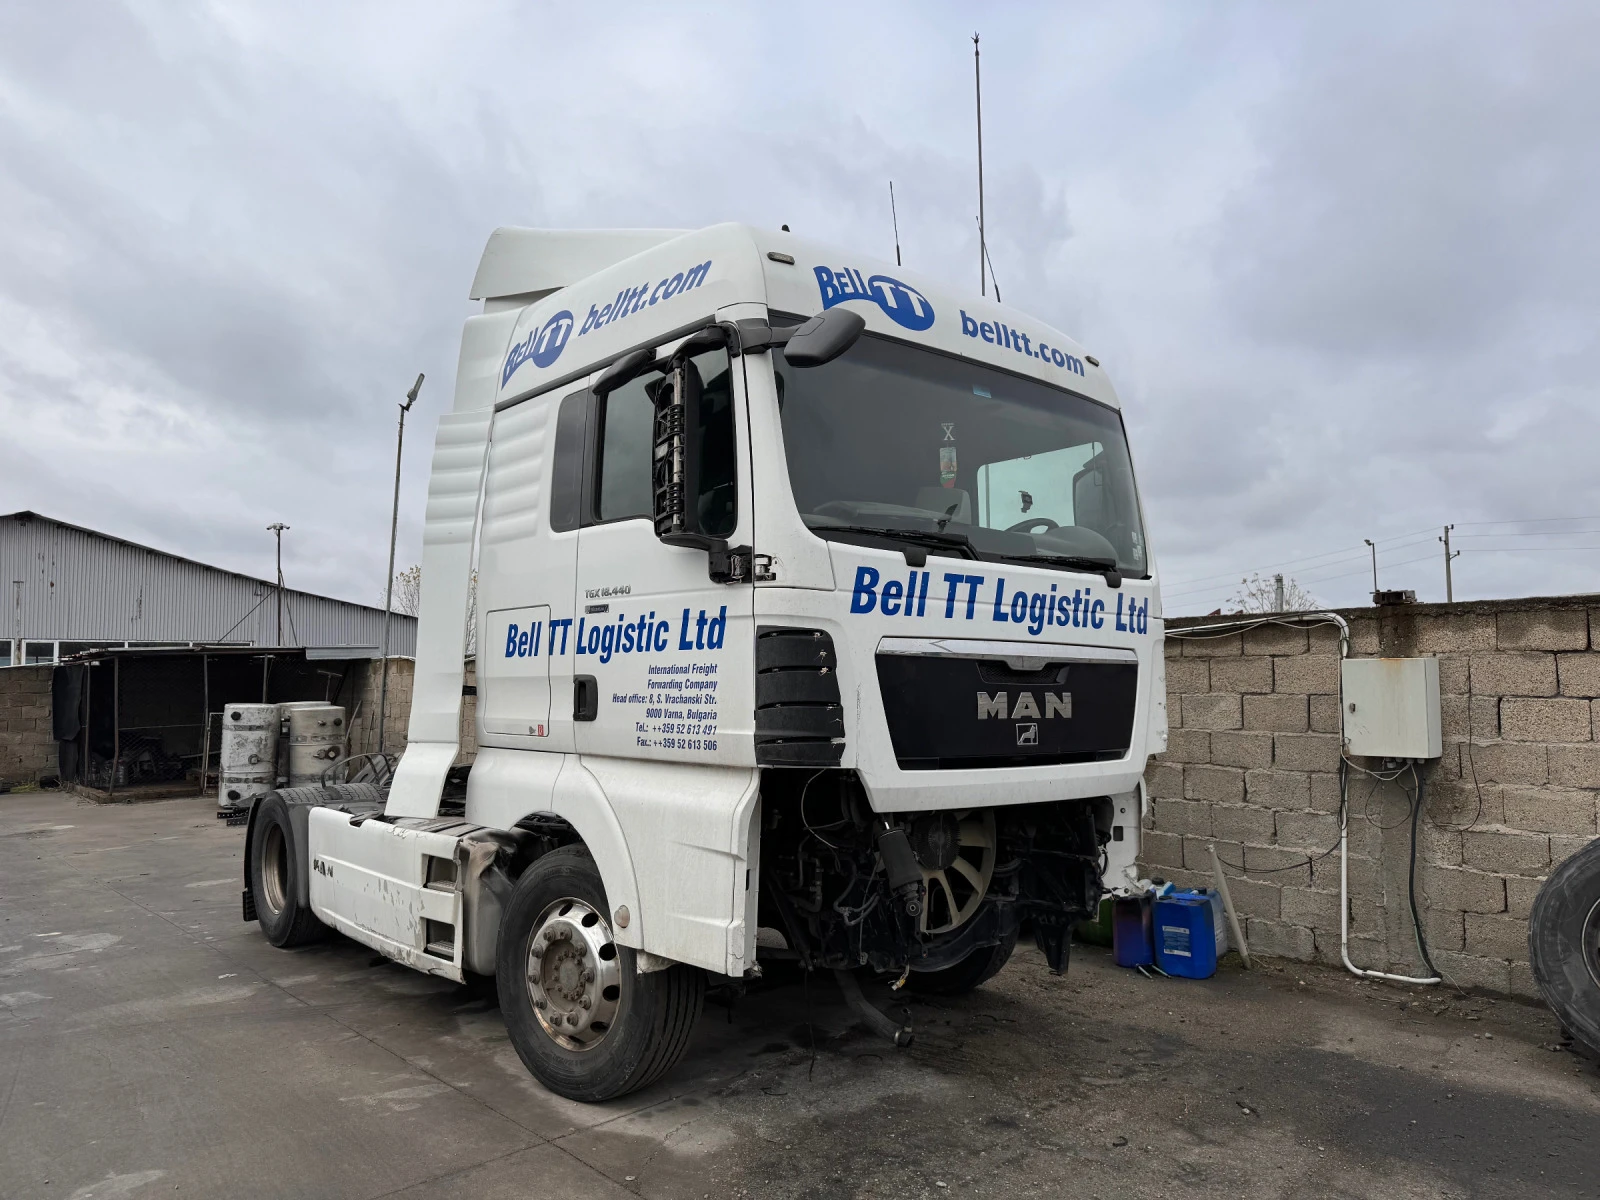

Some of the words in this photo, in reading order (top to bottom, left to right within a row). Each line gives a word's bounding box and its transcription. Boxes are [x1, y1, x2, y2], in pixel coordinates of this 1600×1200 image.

[578, 260, 712, 336] belltt.com
[959, 309, 1085, 377] belltt.com
[584, 588, 600, 599] TGX
[601, 584, 632, 598] 18.440
[849, 565, 930, 617] Bell
[943, 572, 985, 620] TT
[992, 577, 1106, 636] Logistic
[1115, 592, 1149, 635] Ltd
[504, 620, 542, 658] Bell
[549, 618, 573, 656] TT
[576, 611, 670, 664] Logistic
[678, 605, 728, 651] Ltd
[648, 664, 691, 675] International
[691, 663, 718, 676] Freight
[647, 679, 683, 692] Forwarding
[684, 678, 718, 692] Company
[612, 693, 628, 703] Head
[628, 693, 648, 704] office:
[656, 693, 663, 704] S.
[664, 693, 703, 705] Vrachanski
[704, 693, 717, 705] Str.
[976, 691, 1072, 719] MAN
[645, 708, 663, 719] 9000
[663, 708, 685, 721] Varna,
[686, 708, 718, 722] Bulgaria
[675, 723, 686, 734] 52
[686, 723, 701, 735] 613
[702, 724, 718, 736] 491
[676, 738, 686, 750] 52
[687, 739, 702, 750] 613
[703, 739, 718, 751] 506
